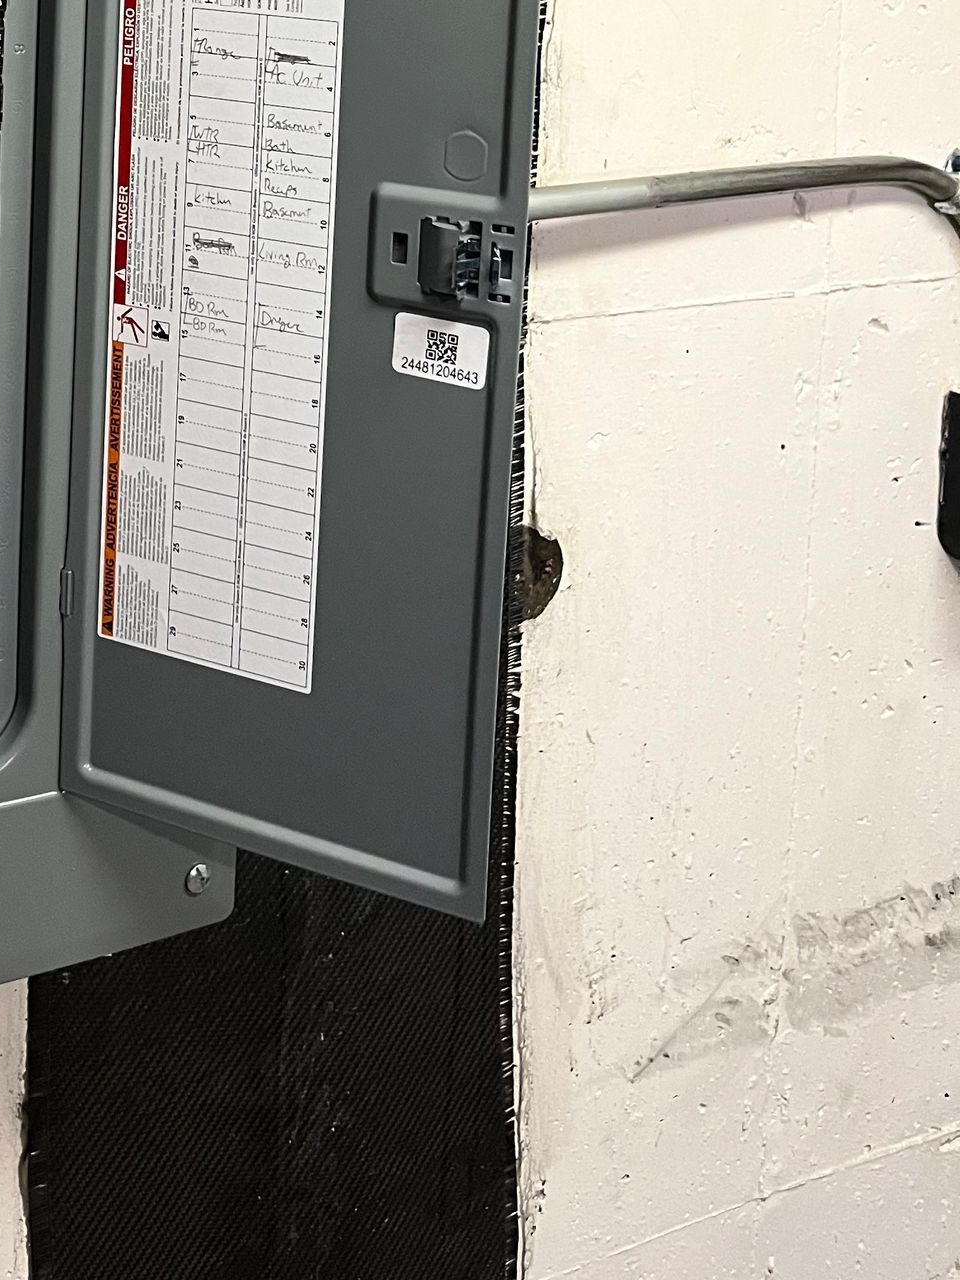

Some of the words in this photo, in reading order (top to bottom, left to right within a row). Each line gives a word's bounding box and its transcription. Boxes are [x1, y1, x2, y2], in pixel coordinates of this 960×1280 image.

[123, 8, 135, 66] PELIGRO
[117, 185, 128, 241] DANGER
[320, 220, 327, 229] 10
[318, 265, 325, 274] 12
[184, 287, 190, 295] 13
[316, 310, 323, 319] 14
[182, 330, 188, 338] 15
[313, 355, 320, 364] 16
[401, 355, 479, 385] 24481204643
[180, 372, 186, 381] 17
[110, 346, 122, 452] AVERTISSEMENT
[312, 399, 318, 408] 18
[178, 416, 184, 425] 19
[309, 444, 316, 454] 20
[176, 458, 183, 468] 21
[307, 488, 314, 498] 22
[106, 462, 117, 552] ADVERTENCIA
[174, 501, 181, 510] 23
[305, 532, 312, 541] 24
[173, 543, 180, 553] 25
[303, 575, 310, 585] 26
[103, 559, 114, 617] WARNING
[171, 585, 177, 594] 27
[301, 618, 308, 628] 28
[169, 627, 176, 636] 29
[299, 661, 306, 671] 30
